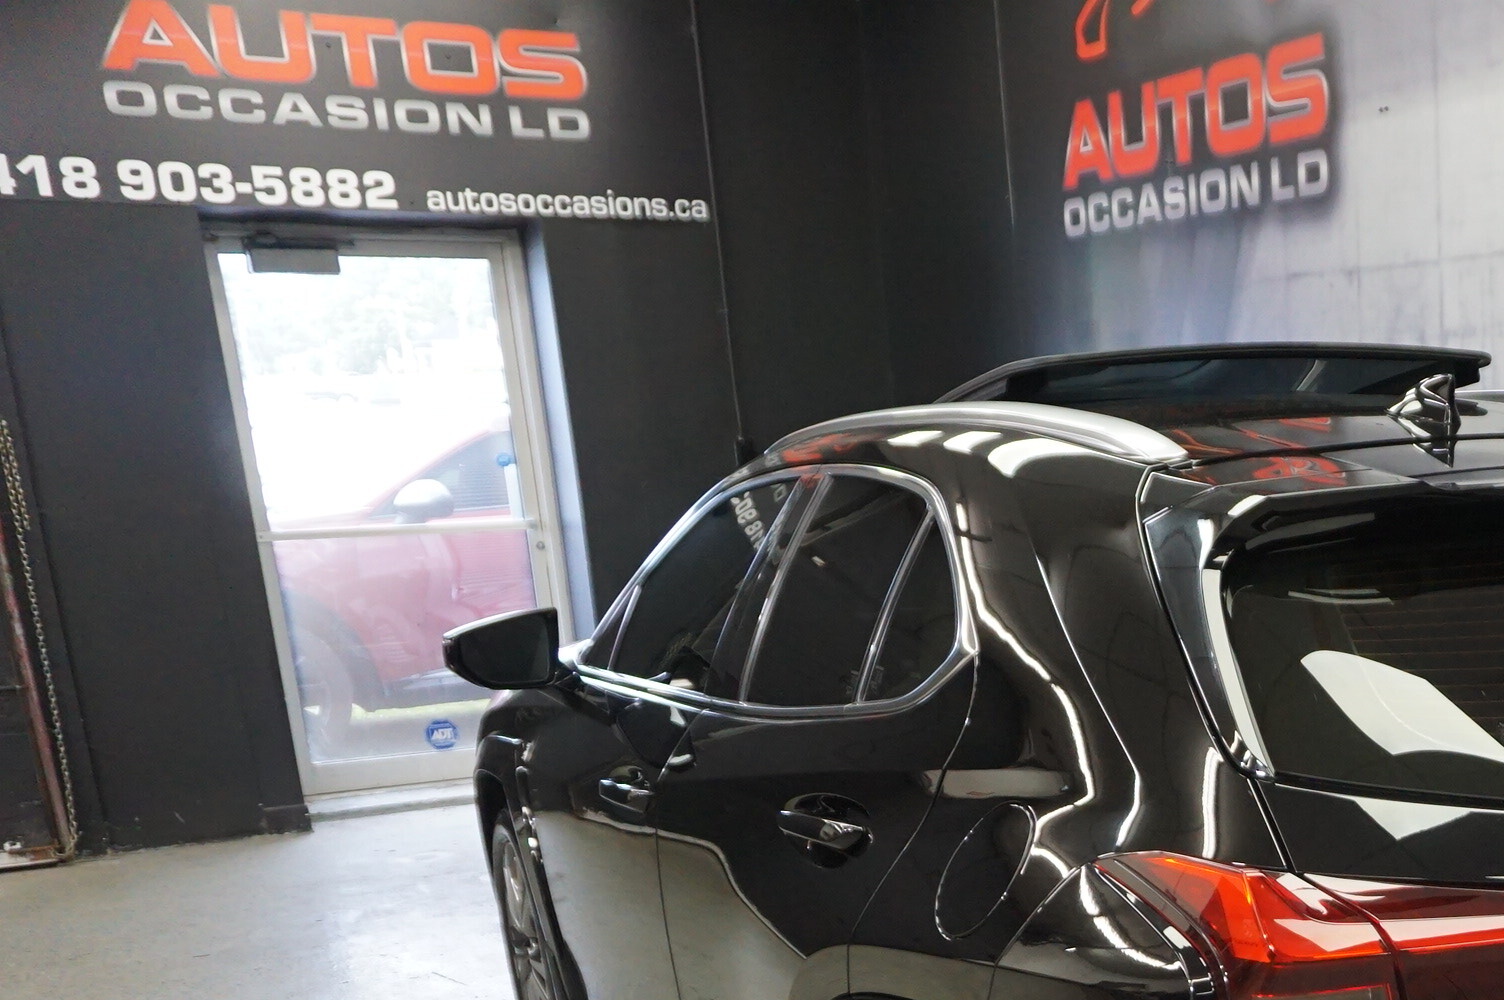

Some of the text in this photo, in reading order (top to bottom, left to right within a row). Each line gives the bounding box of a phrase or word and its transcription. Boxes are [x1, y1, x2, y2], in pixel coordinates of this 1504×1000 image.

[102, 0, 588, 99] AUTOS
[102, 80, 591, 140] OCCASION LD
[1062, 32, 1330, 191] AUTOS
[116, 158, 399, 210] 903-5882
[426, 187, 709, 222] autosoccasions.ca
[1063, 149, 1329, 239] OCCASION LD
